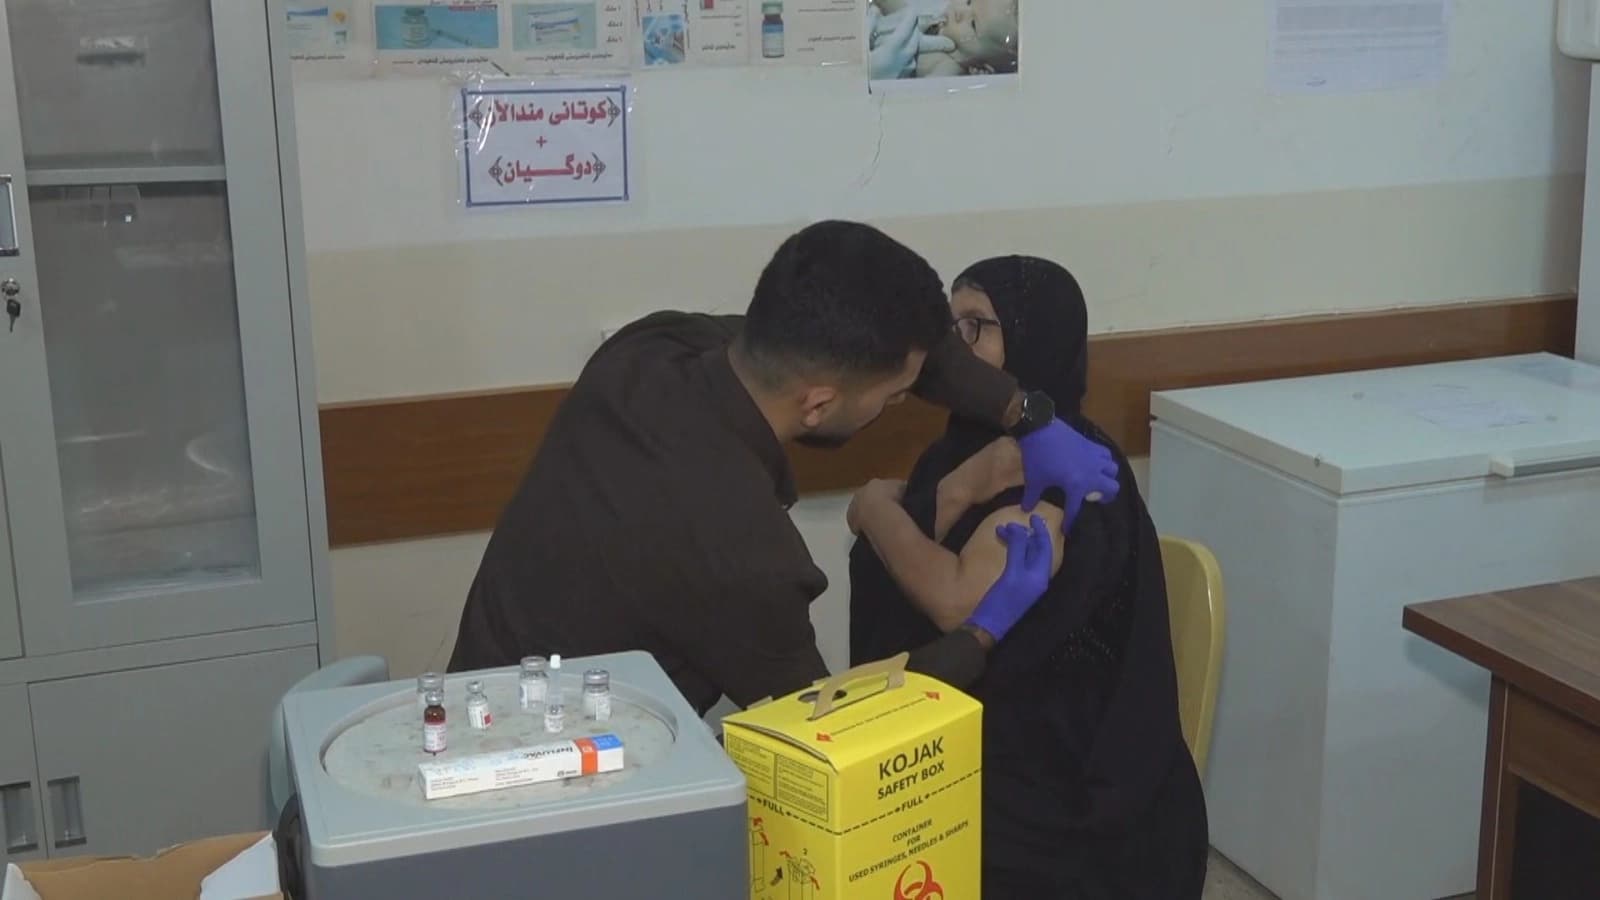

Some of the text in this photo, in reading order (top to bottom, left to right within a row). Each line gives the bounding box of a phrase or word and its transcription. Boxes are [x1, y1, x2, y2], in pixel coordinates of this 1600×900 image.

[879, 736, 944, 780] KOJAK
[877, 760, 944, 800] SAFETY BOX
[763, 799, 784, 816] FULL
[901, 795, 923, 812] FULL
[892, 818, 932, 842] CONTAINER
[906, 834, 921, 847] FOR
[848, 868, 869, 882] USED
[908, 836, 937, 856] NEEDLES
[945, 819, 969, 839] SHARPS
